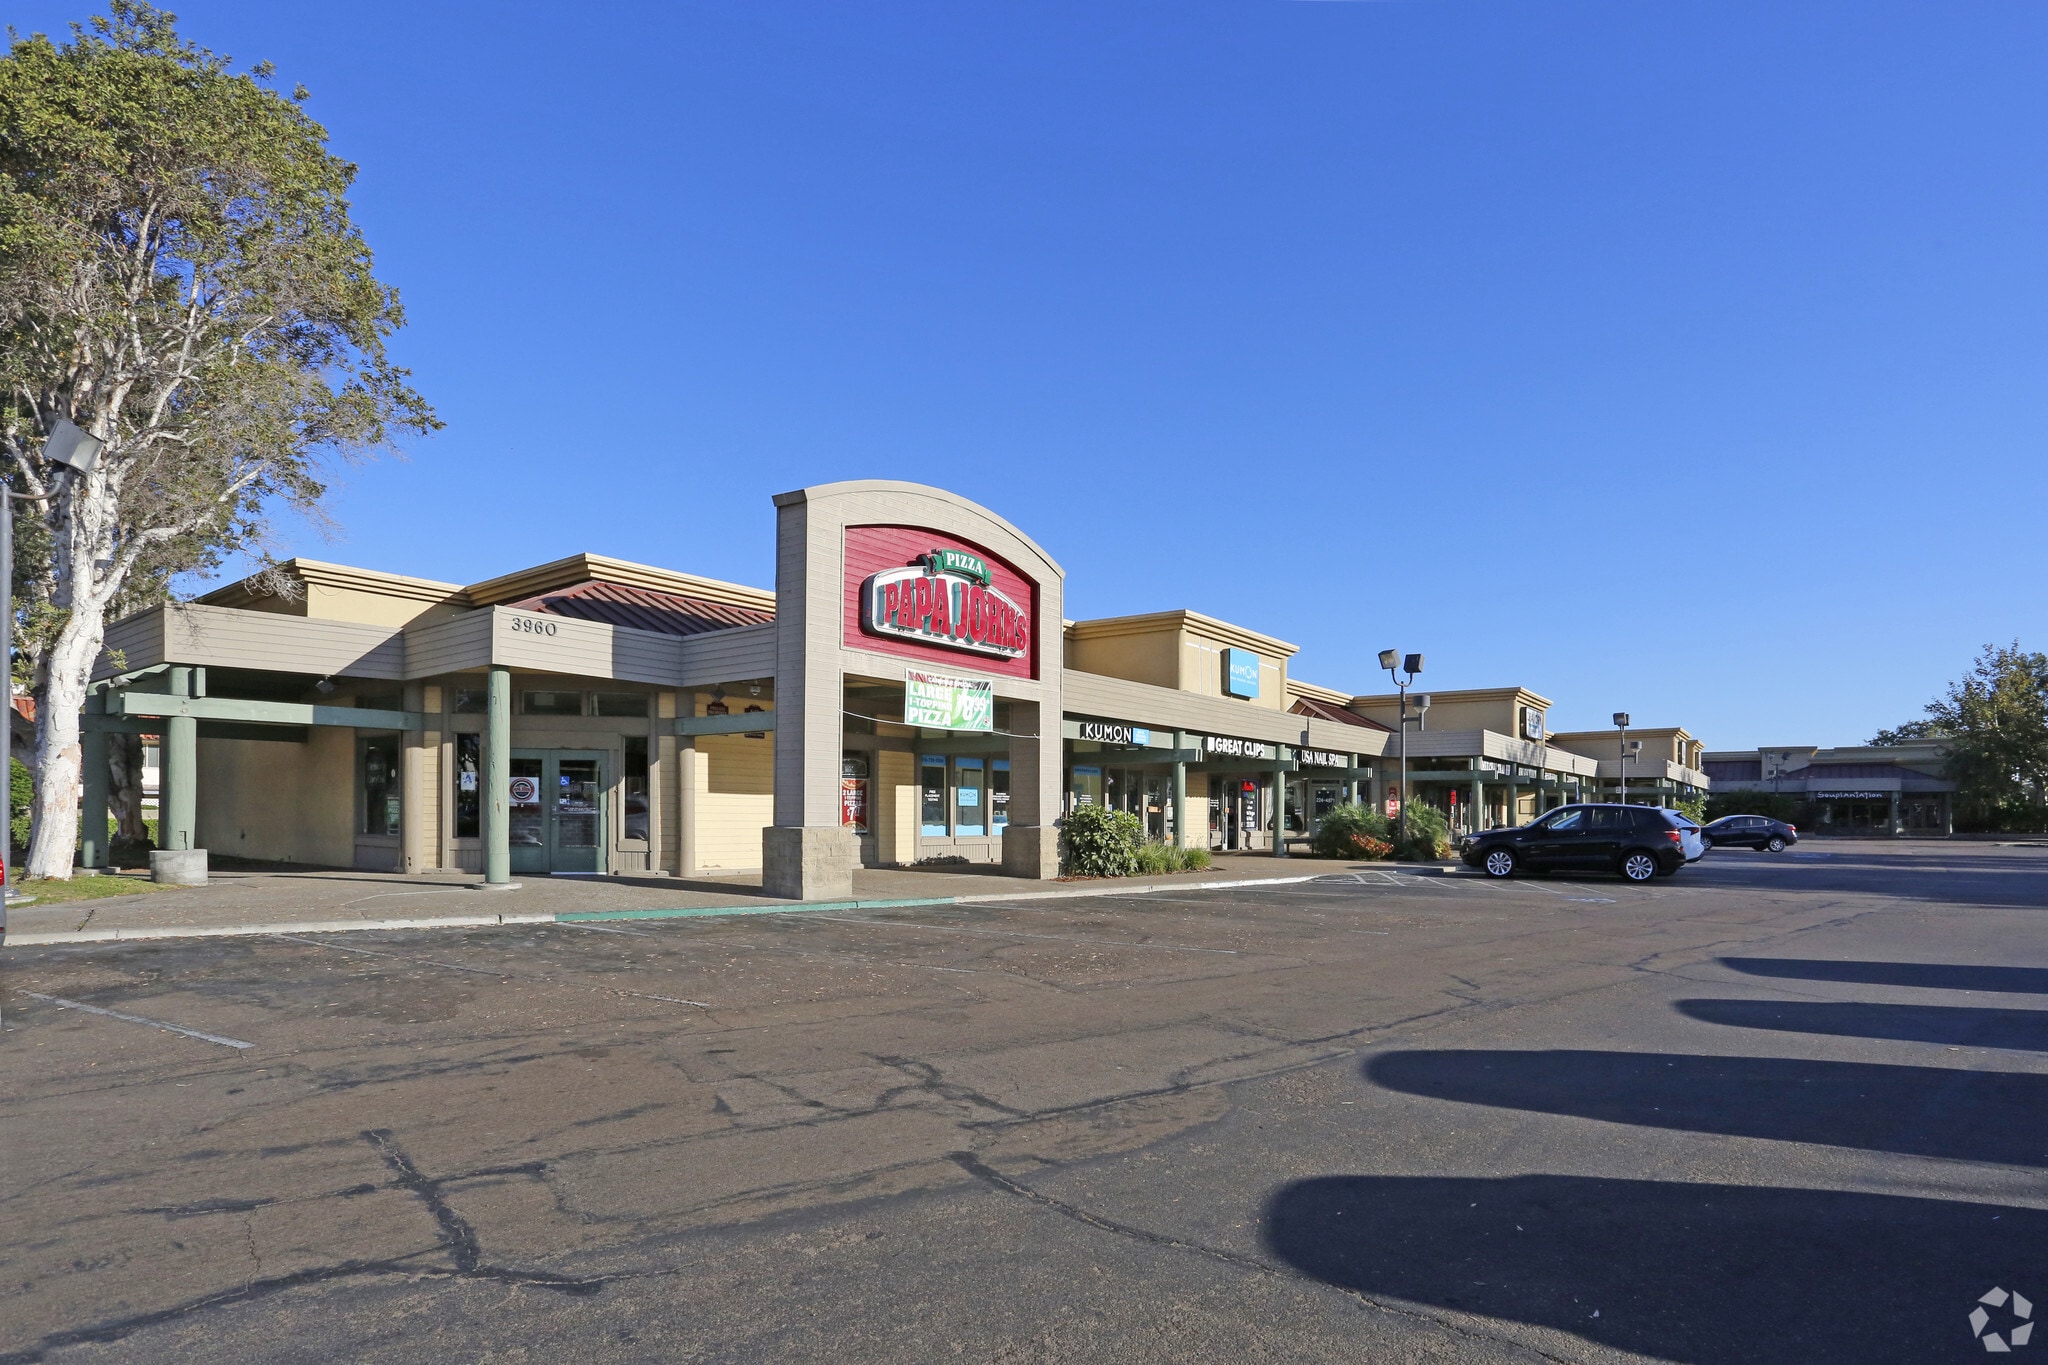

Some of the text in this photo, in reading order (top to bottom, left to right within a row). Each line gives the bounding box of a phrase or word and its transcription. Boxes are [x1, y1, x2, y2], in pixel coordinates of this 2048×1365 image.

[946, 552, 983, 575] PIZZA
[883, 577, 1028, 652] PAPA JOHN'S
[511, 617, 557, 637] 3960
[1230, 664, 1258, 680] KUMON
[909, 680, 953, 701] LARGE
[908, 707, 952, 727] PIZZA
[1085, 723, 1132, 742] KUMON
[1215, 737, 1266, 758] GREAT CLIPS
[1301, 749, 1339, 767] USA NAIL SPA
[1817, 791, 1883, 800] Souplantation
